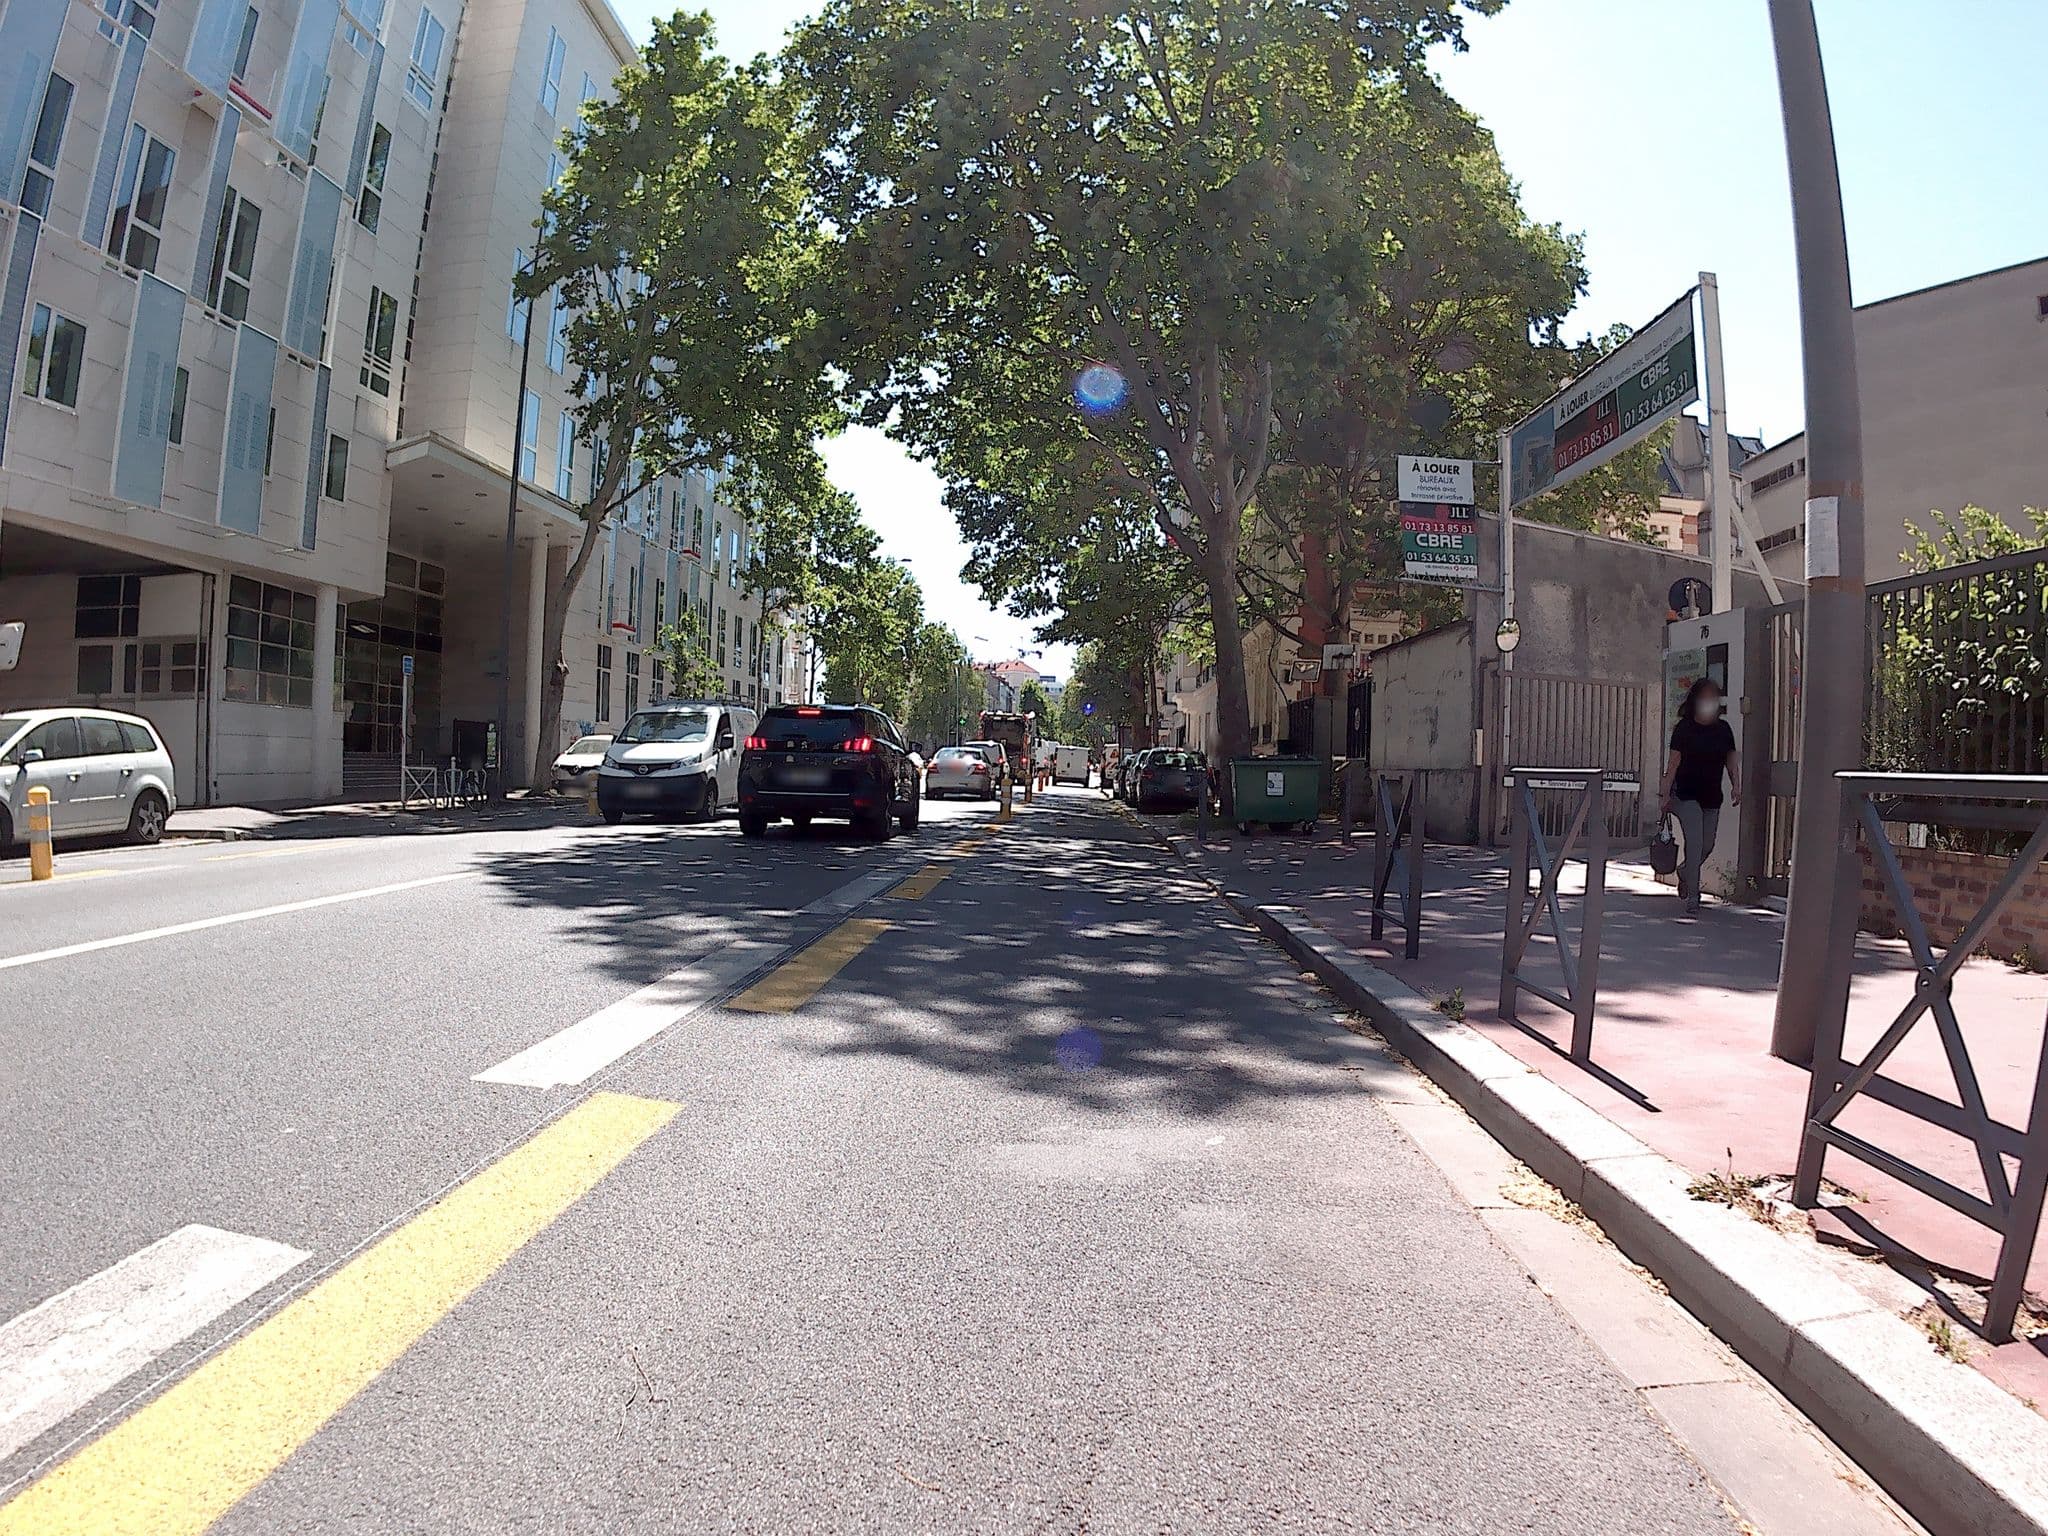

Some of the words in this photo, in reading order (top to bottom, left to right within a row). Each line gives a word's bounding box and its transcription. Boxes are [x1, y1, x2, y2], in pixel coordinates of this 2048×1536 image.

[1641, 356, 1670, 390] CBRE
[1560, 404, 1566, 422] À
[1567, 391, 1589, 417] LOUER
[1624, 408, 1635, 429] 01
[1638, 399, 1650, 422] 53
[1651, 389, 1664, 412] 64
[1664, 380, 1676, 404] 35
[1678, 371, 1689, 394] 31
[1597, 400, 1611, 420] JLL
[1559, 450, 1568, 468] 01
[1569, 443, 1578, 462] 73
[1580, 436, 1590, 456] 13
[1590, 430, 1602, 449] 85
[1602, 422, 1614, 442] 81
[1412, 460, 1420, 472] À
[1424, 464, 1460, 475] LOUER
[1419, 475, 1455, 484] BUREAUX
[1450, 506, 1469, 518] JLL
[1405, 521, 1416, 530] 01
[1419, 522, 1430, 531] 73
[1434, 524, 1444, 532] 13
[1448, 524, 1459, 532] 85
[1462, 525, 1474, 534] 81
[1416, 533, 1462, 548] CBRE
[1406, 552, 1418, 560] 01
[1421, 552, 1432, 562] 53
[1435, 554, 1446, 562] 64
[1448, 554, 1460, 563] 35
[1463, 555, 1474, 564] 31
[1602, 772, 1634, 780] RAISONS
